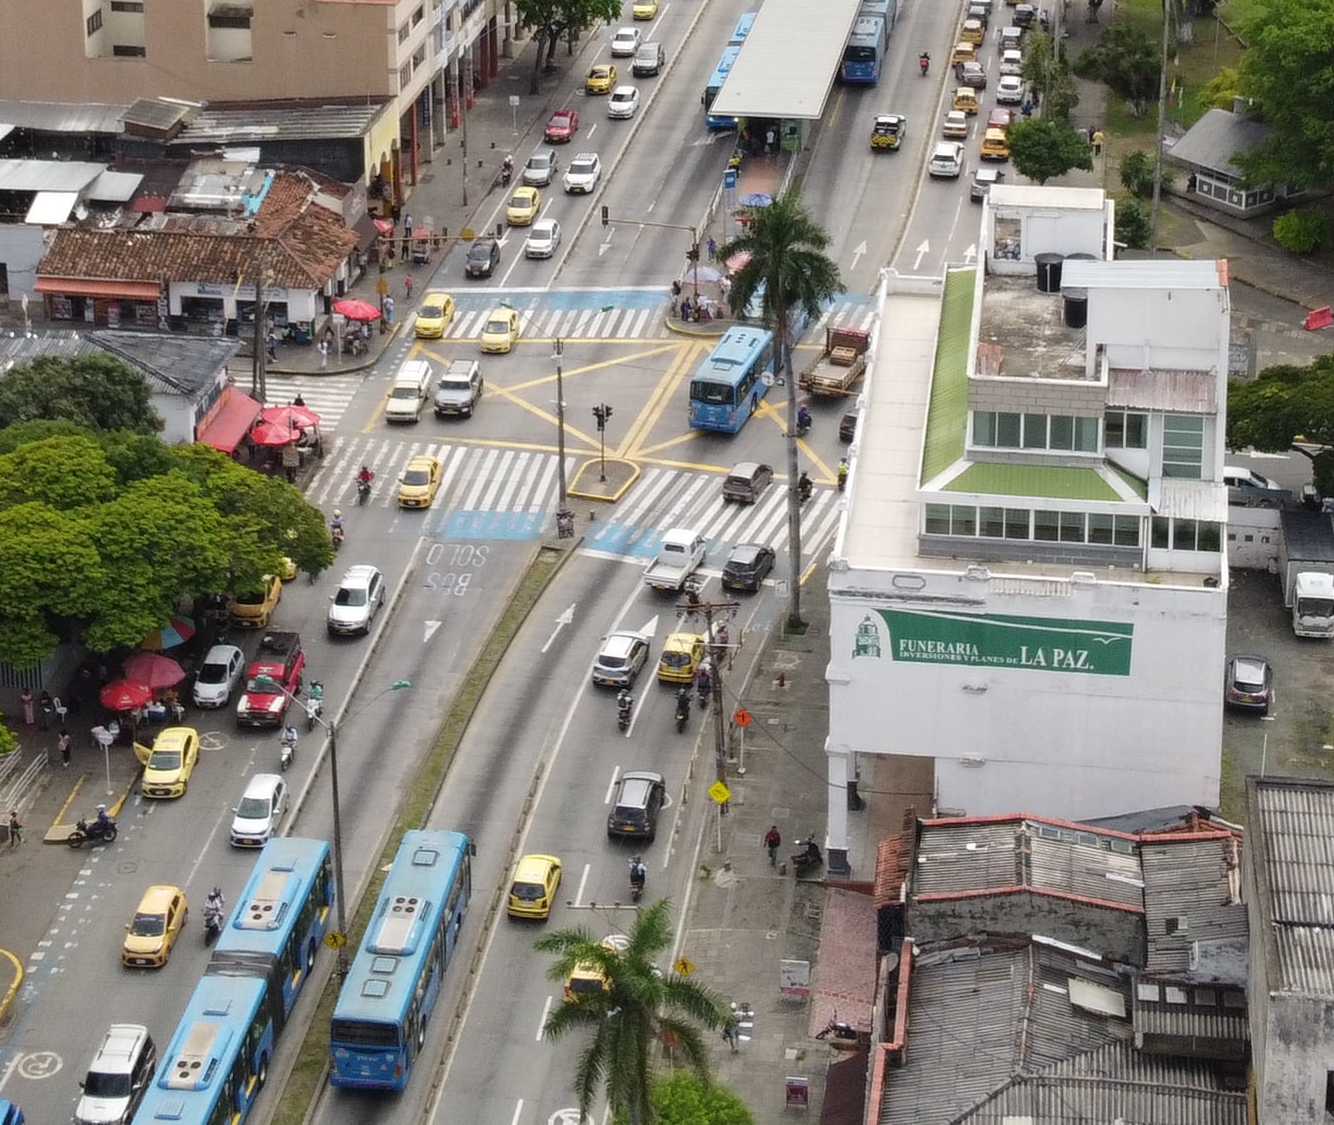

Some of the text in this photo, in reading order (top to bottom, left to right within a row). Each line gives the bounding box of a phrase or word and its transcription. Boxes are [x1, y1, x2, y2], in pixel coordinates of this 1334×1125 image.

[426, 543, 489, 567] SOLO
[426, 571, 472, 596] BUS
[899, 638, 979, 656] FUNERARIA
[899, 651, 962, 661] INVERSIONES
[970, 655, 1005, 663] PLANES
[1020, 645, 1095, 670] LA PAZ.
